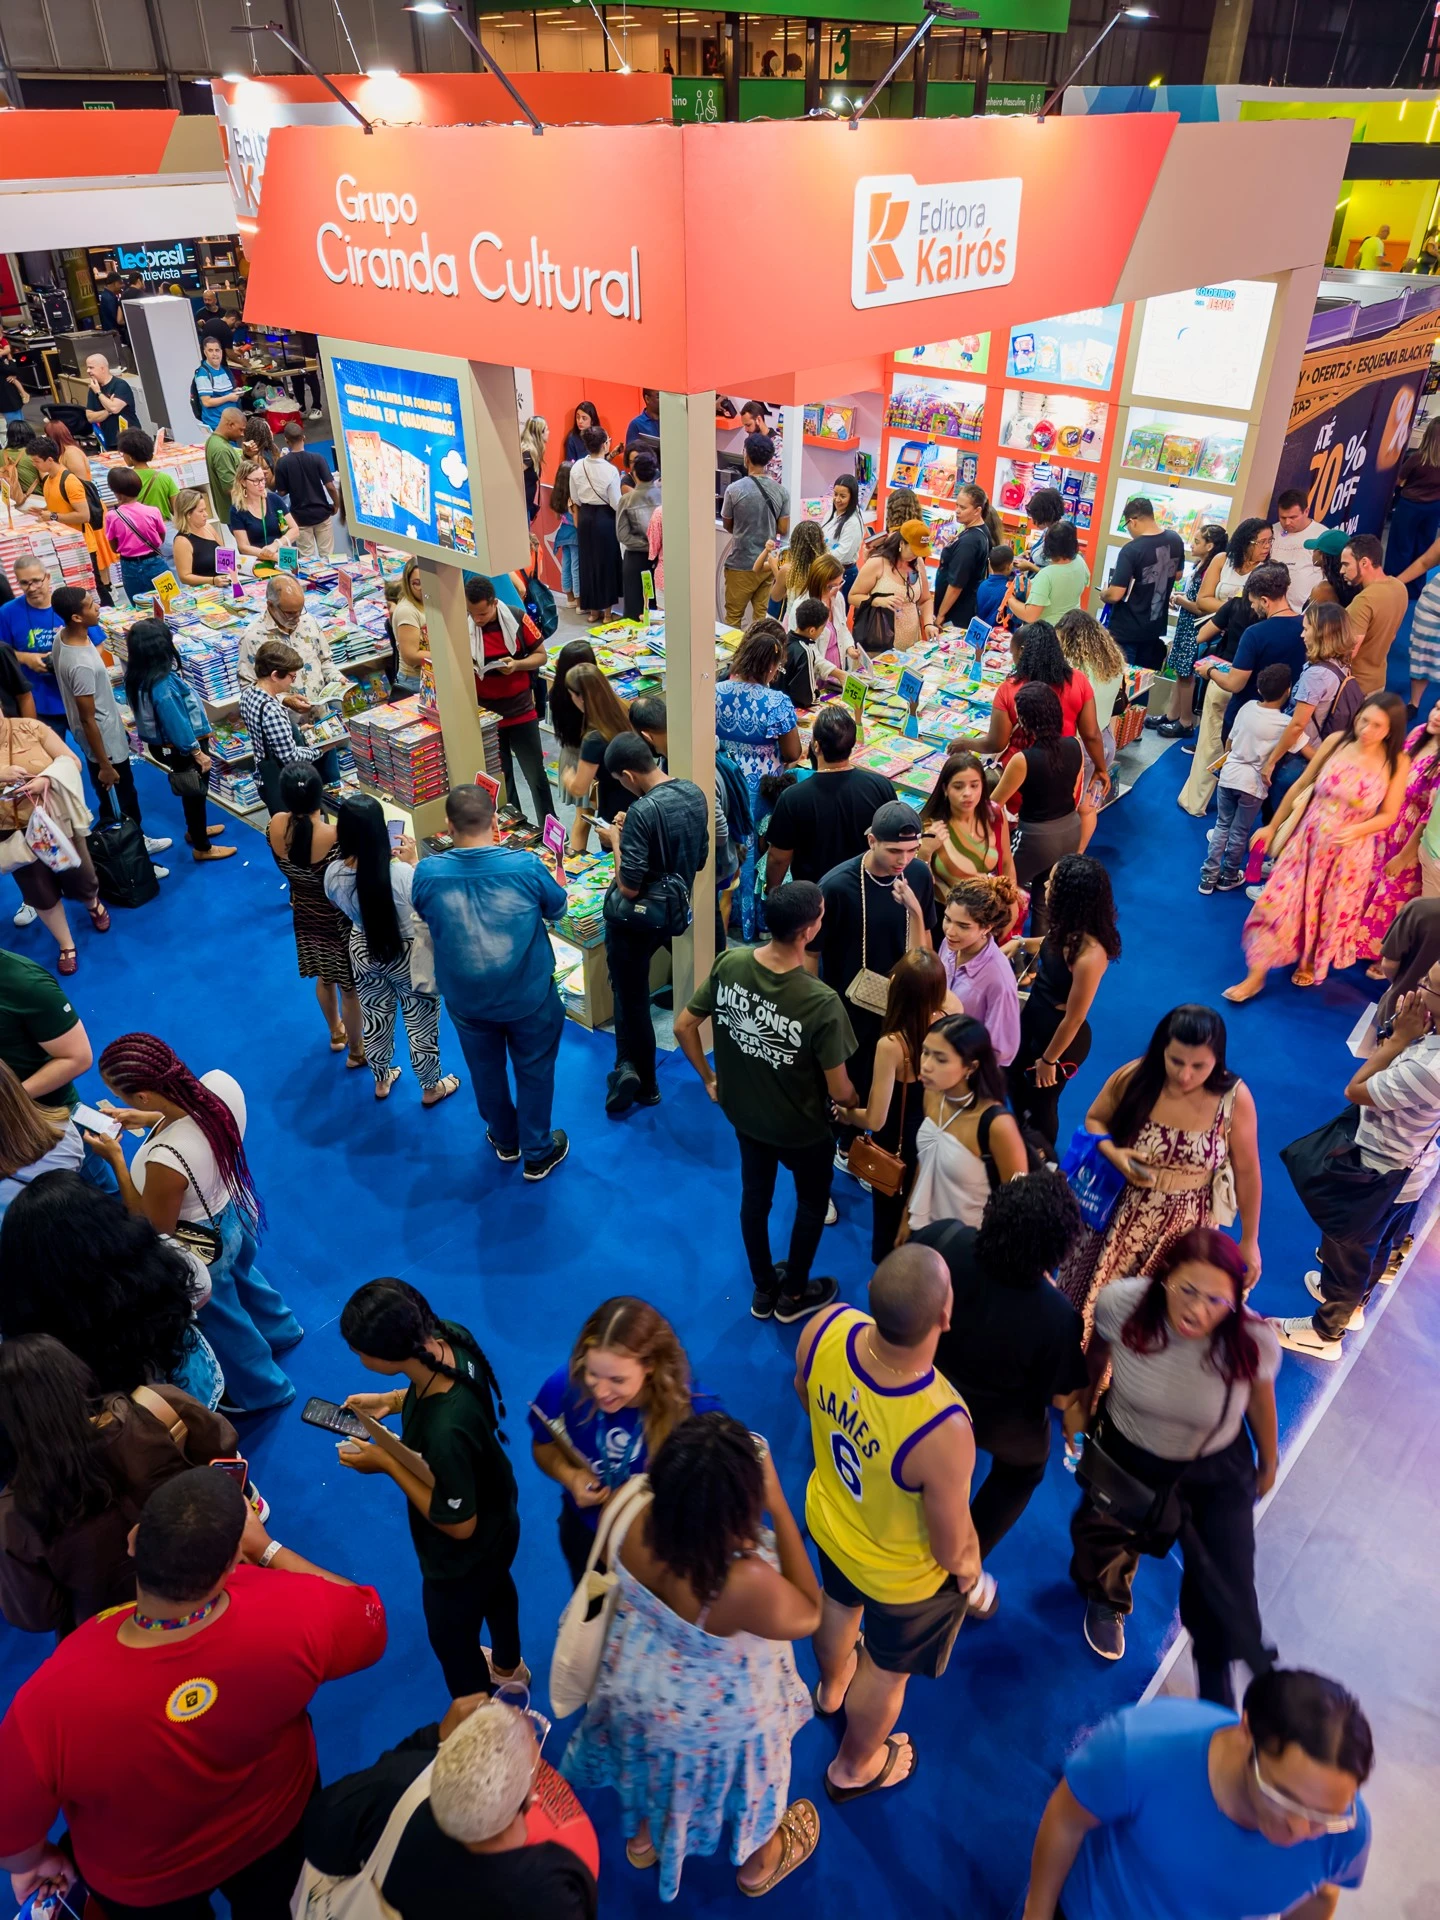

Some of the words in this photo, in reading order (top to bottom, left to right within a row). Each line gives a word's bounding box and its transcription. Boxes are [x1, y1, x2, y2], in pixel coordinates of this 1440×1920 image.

[834, 27, 851, 74] 3
[985, 96, 1003, 106] anheiro
[233, 126, 268, 166] Edit
[335, 174, 418, 238] Grupo
[919, 198, 987, 236] Editora
[141, 267, 181, 281] ntrevista
[316, 222, 459, 298] Ciranda
[469, 231, 642, 323] Cultural
[916, 227, 1007, 287] Kairós
[1195, 287, 1236, 299] COLORINDO
[1398, 343, 1426, 364] BLACK
[1314, 415, 1337, 452] ATÉ
[1329, 476, 1360, 515] OFF
[163, 582, 173, 593] 30
[849, 689, 858, 700] 15
[732, 982, 749, 997] MADE
[752, 992, 761, 1003] IN
[762, 999, 777, 1012] CALI
[717, 1014, 760, 1048] NER
[761, 1043, 794, 1065] DYE
[755, 1005, 802, 1048] ONES
[816, 1383, 880, 1459] JAMES
[830, 1431, 862, 1504] 6
